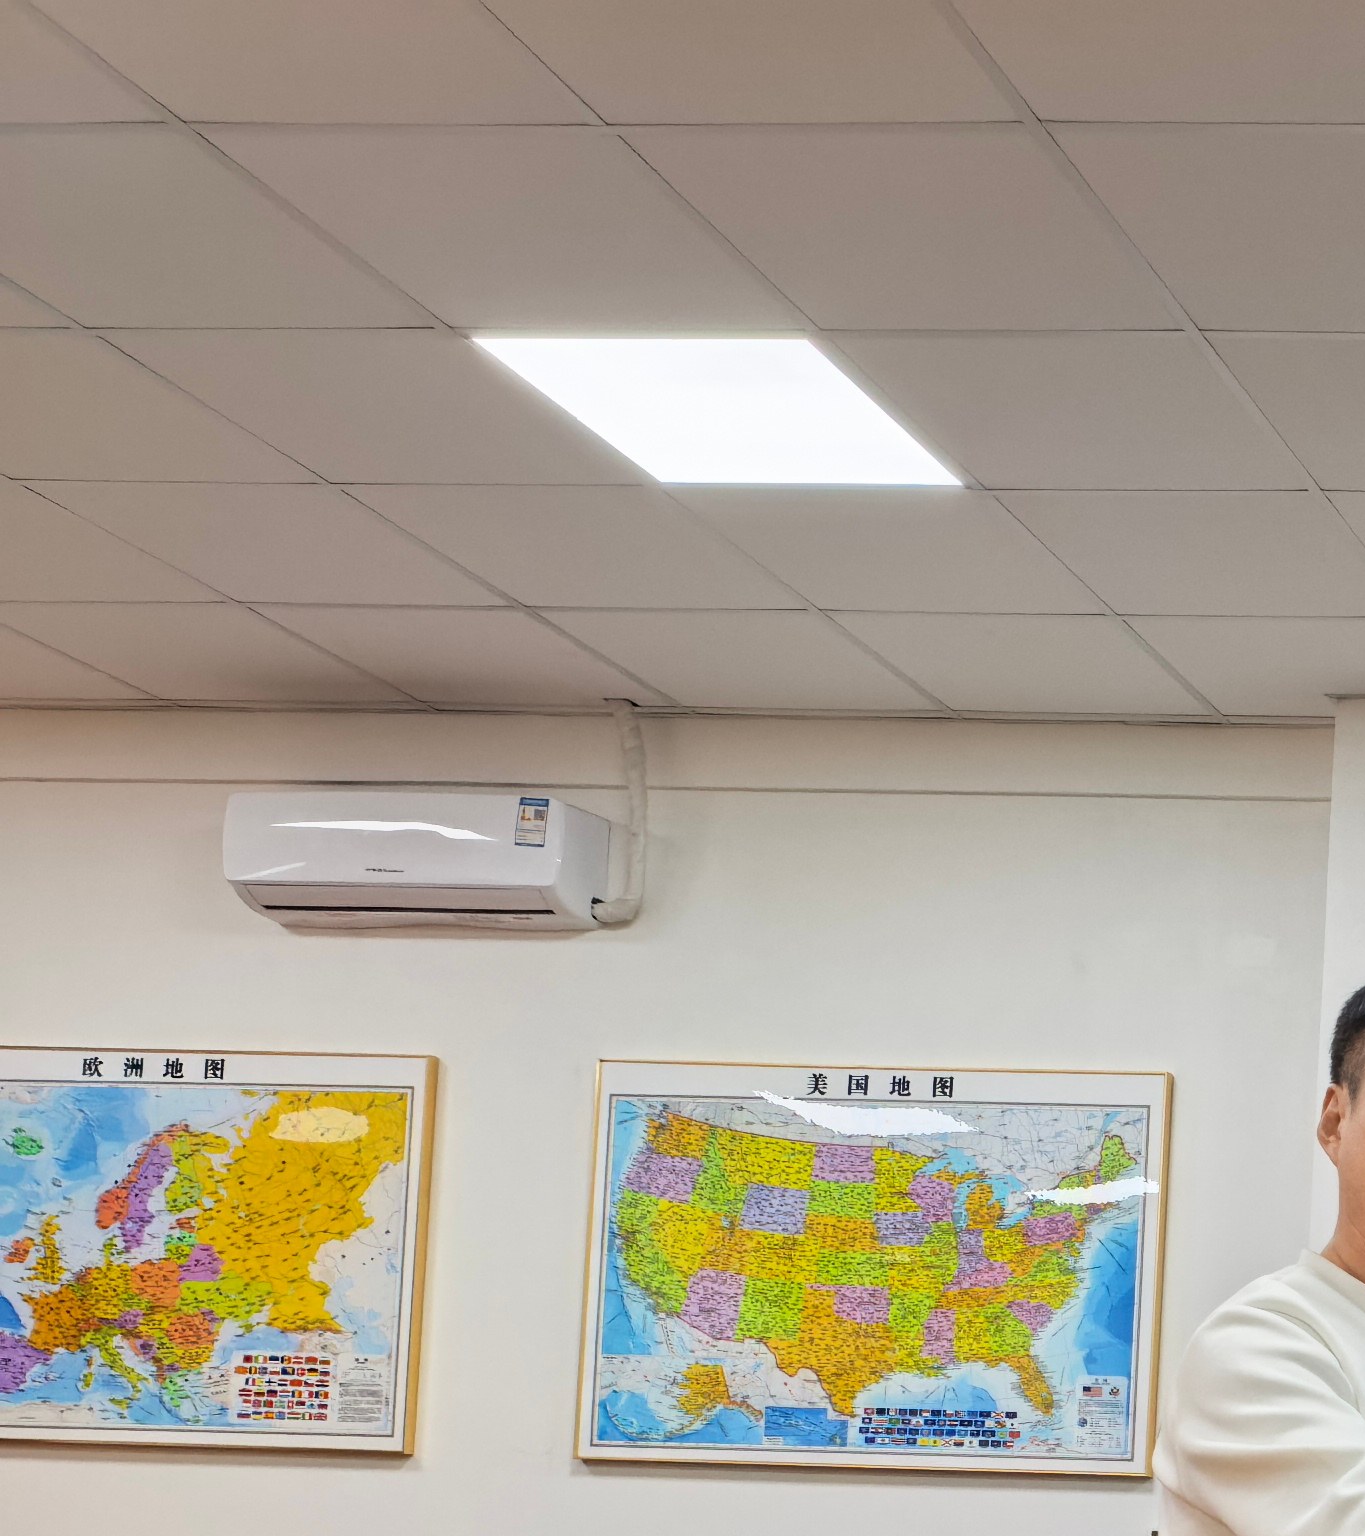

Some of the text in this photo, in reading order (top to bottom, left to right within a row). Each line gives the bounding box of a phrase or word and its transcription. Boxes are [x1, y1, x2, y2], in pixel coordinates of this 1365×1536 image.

[81, 1056, 226, 1080] 欧洲地图
[806, 1073, 955, 1098] 美国地图
